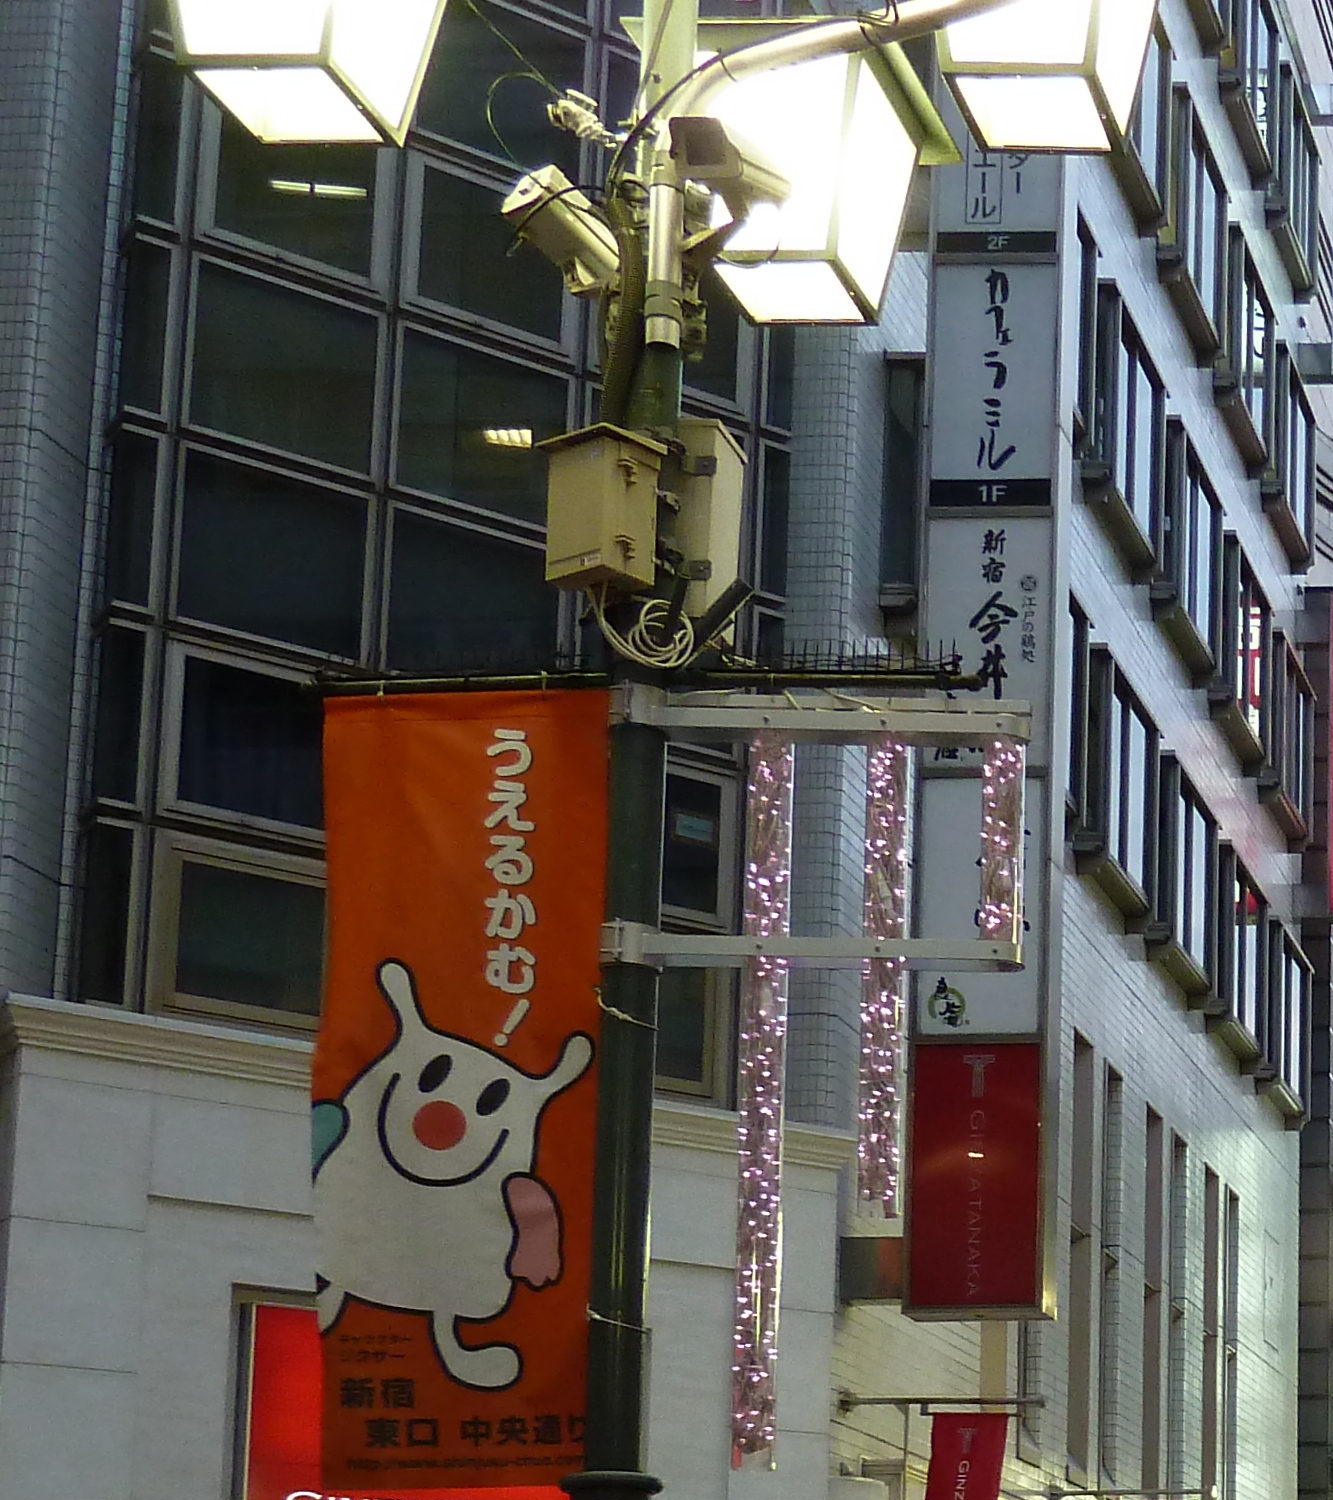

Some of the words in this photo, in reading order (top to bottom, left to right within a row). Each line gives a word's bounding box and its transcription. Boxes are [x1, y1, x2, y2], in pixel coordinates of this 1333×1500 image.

[987, 236, 1010, 250] 2F
[974, 268, 1016, 472] カフェラミル
[978, 485, 1007, 503] 1F
[967, 1108, 987, 1297] GIATANAKA
[340, 1376, 416, 1409] 新宿
[364, 1417, 440, 1448] 東口
